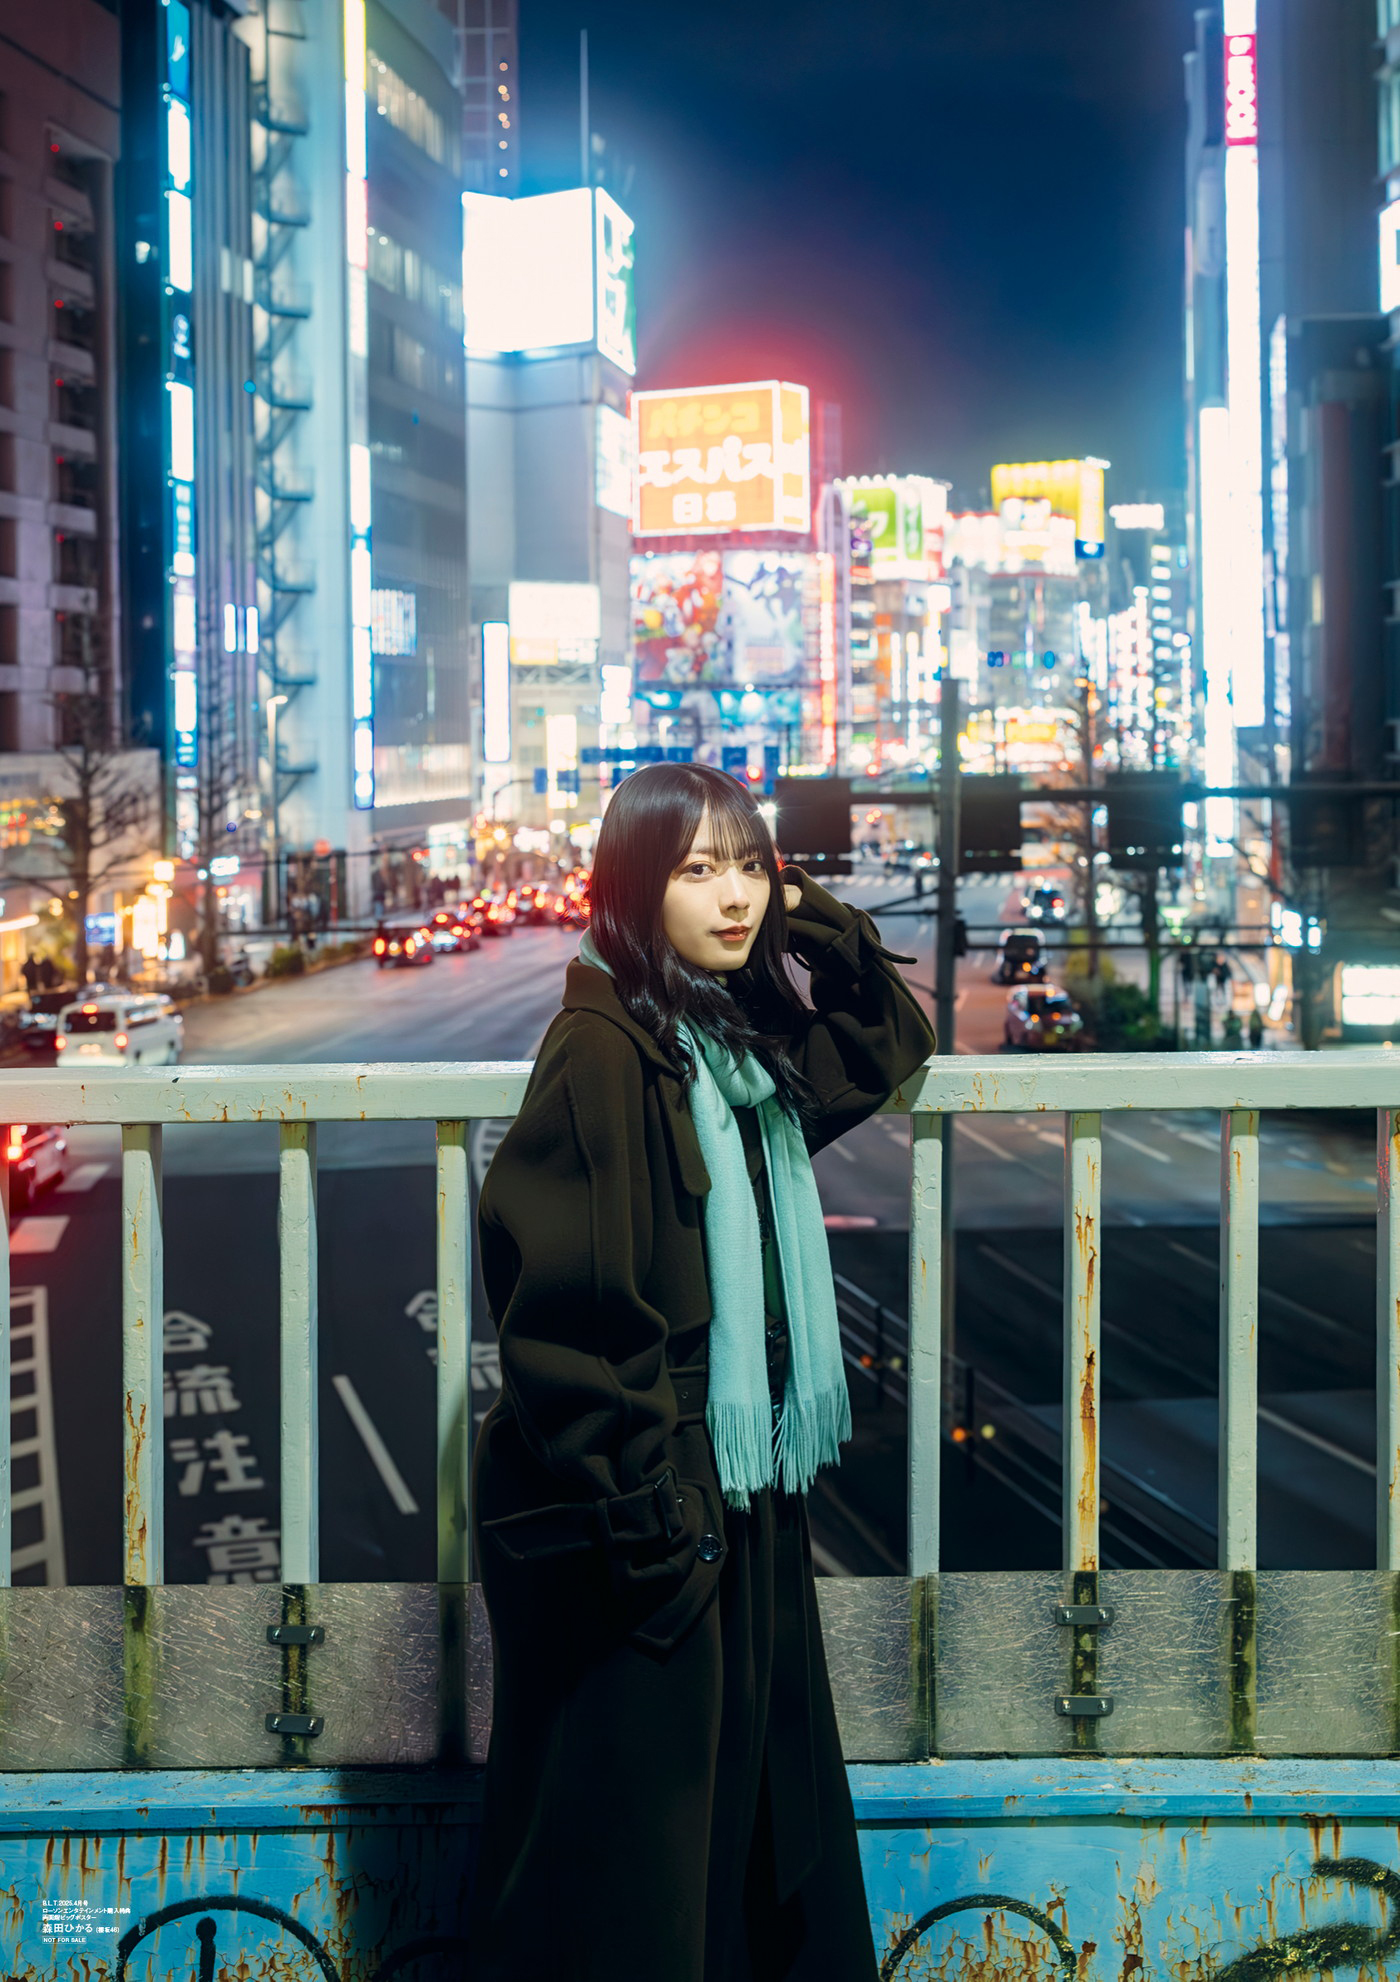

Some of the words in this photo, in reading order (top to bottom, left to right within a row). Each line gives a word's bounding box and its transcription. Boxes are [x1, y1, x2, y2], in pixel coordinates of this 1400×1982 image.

[648, 401, 760, 439] パチンコ
[638, 435, 776, 488] エスパス
[163, 1310, 282, 1584] 合流注意
